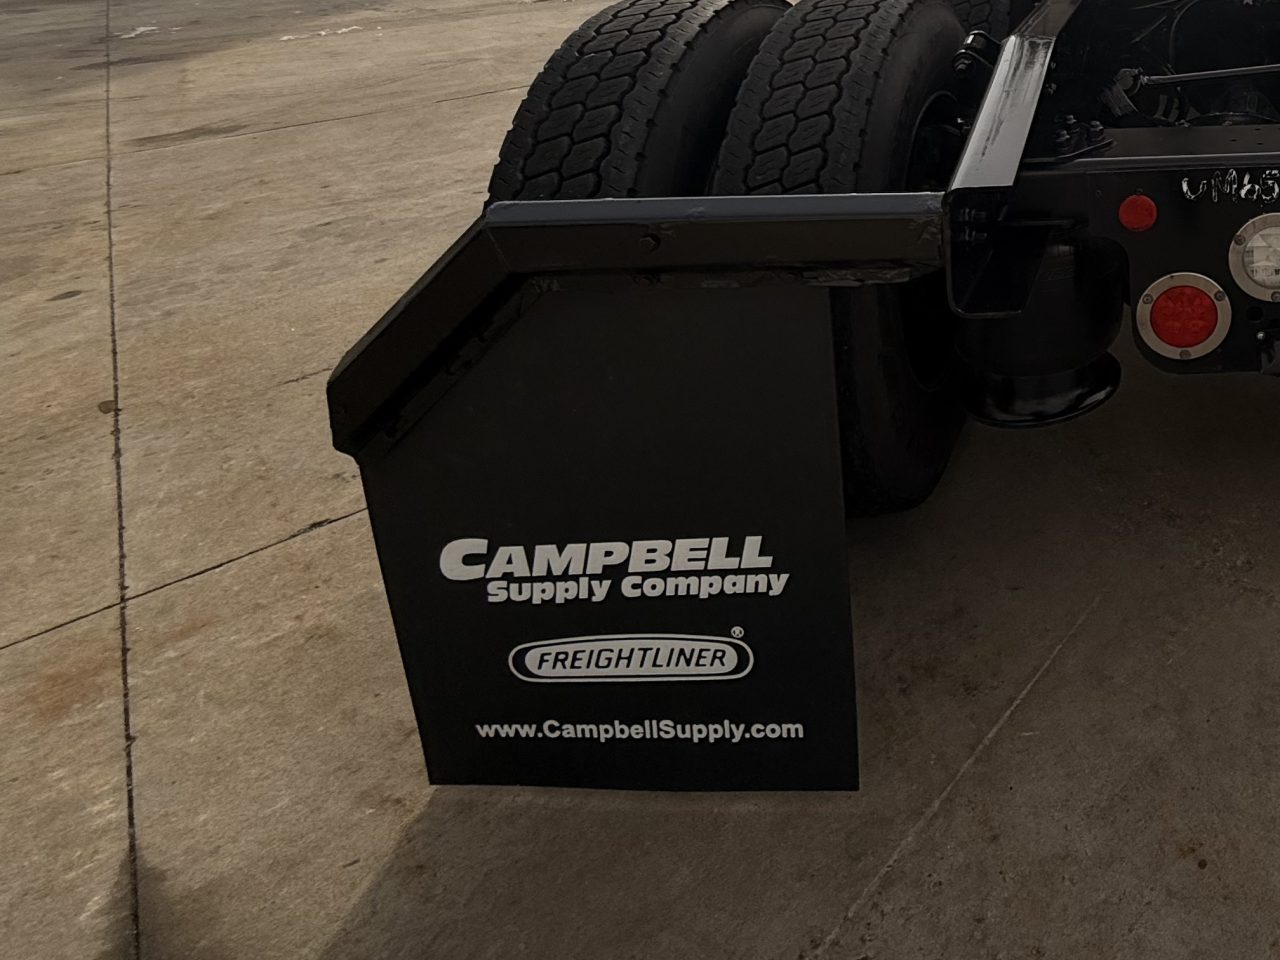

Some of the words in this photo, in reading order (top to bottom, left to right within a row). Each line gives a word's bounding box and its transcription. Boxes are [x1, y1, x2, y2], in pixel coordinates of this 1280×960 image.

[439, 535, 774, 581] CAMPBELL
[487, 575, 612, 604] Supply
[537, 648, 727, 671] FREIGHTLINER
[475, 719, 804, 744] www.CampbellSupply.com
